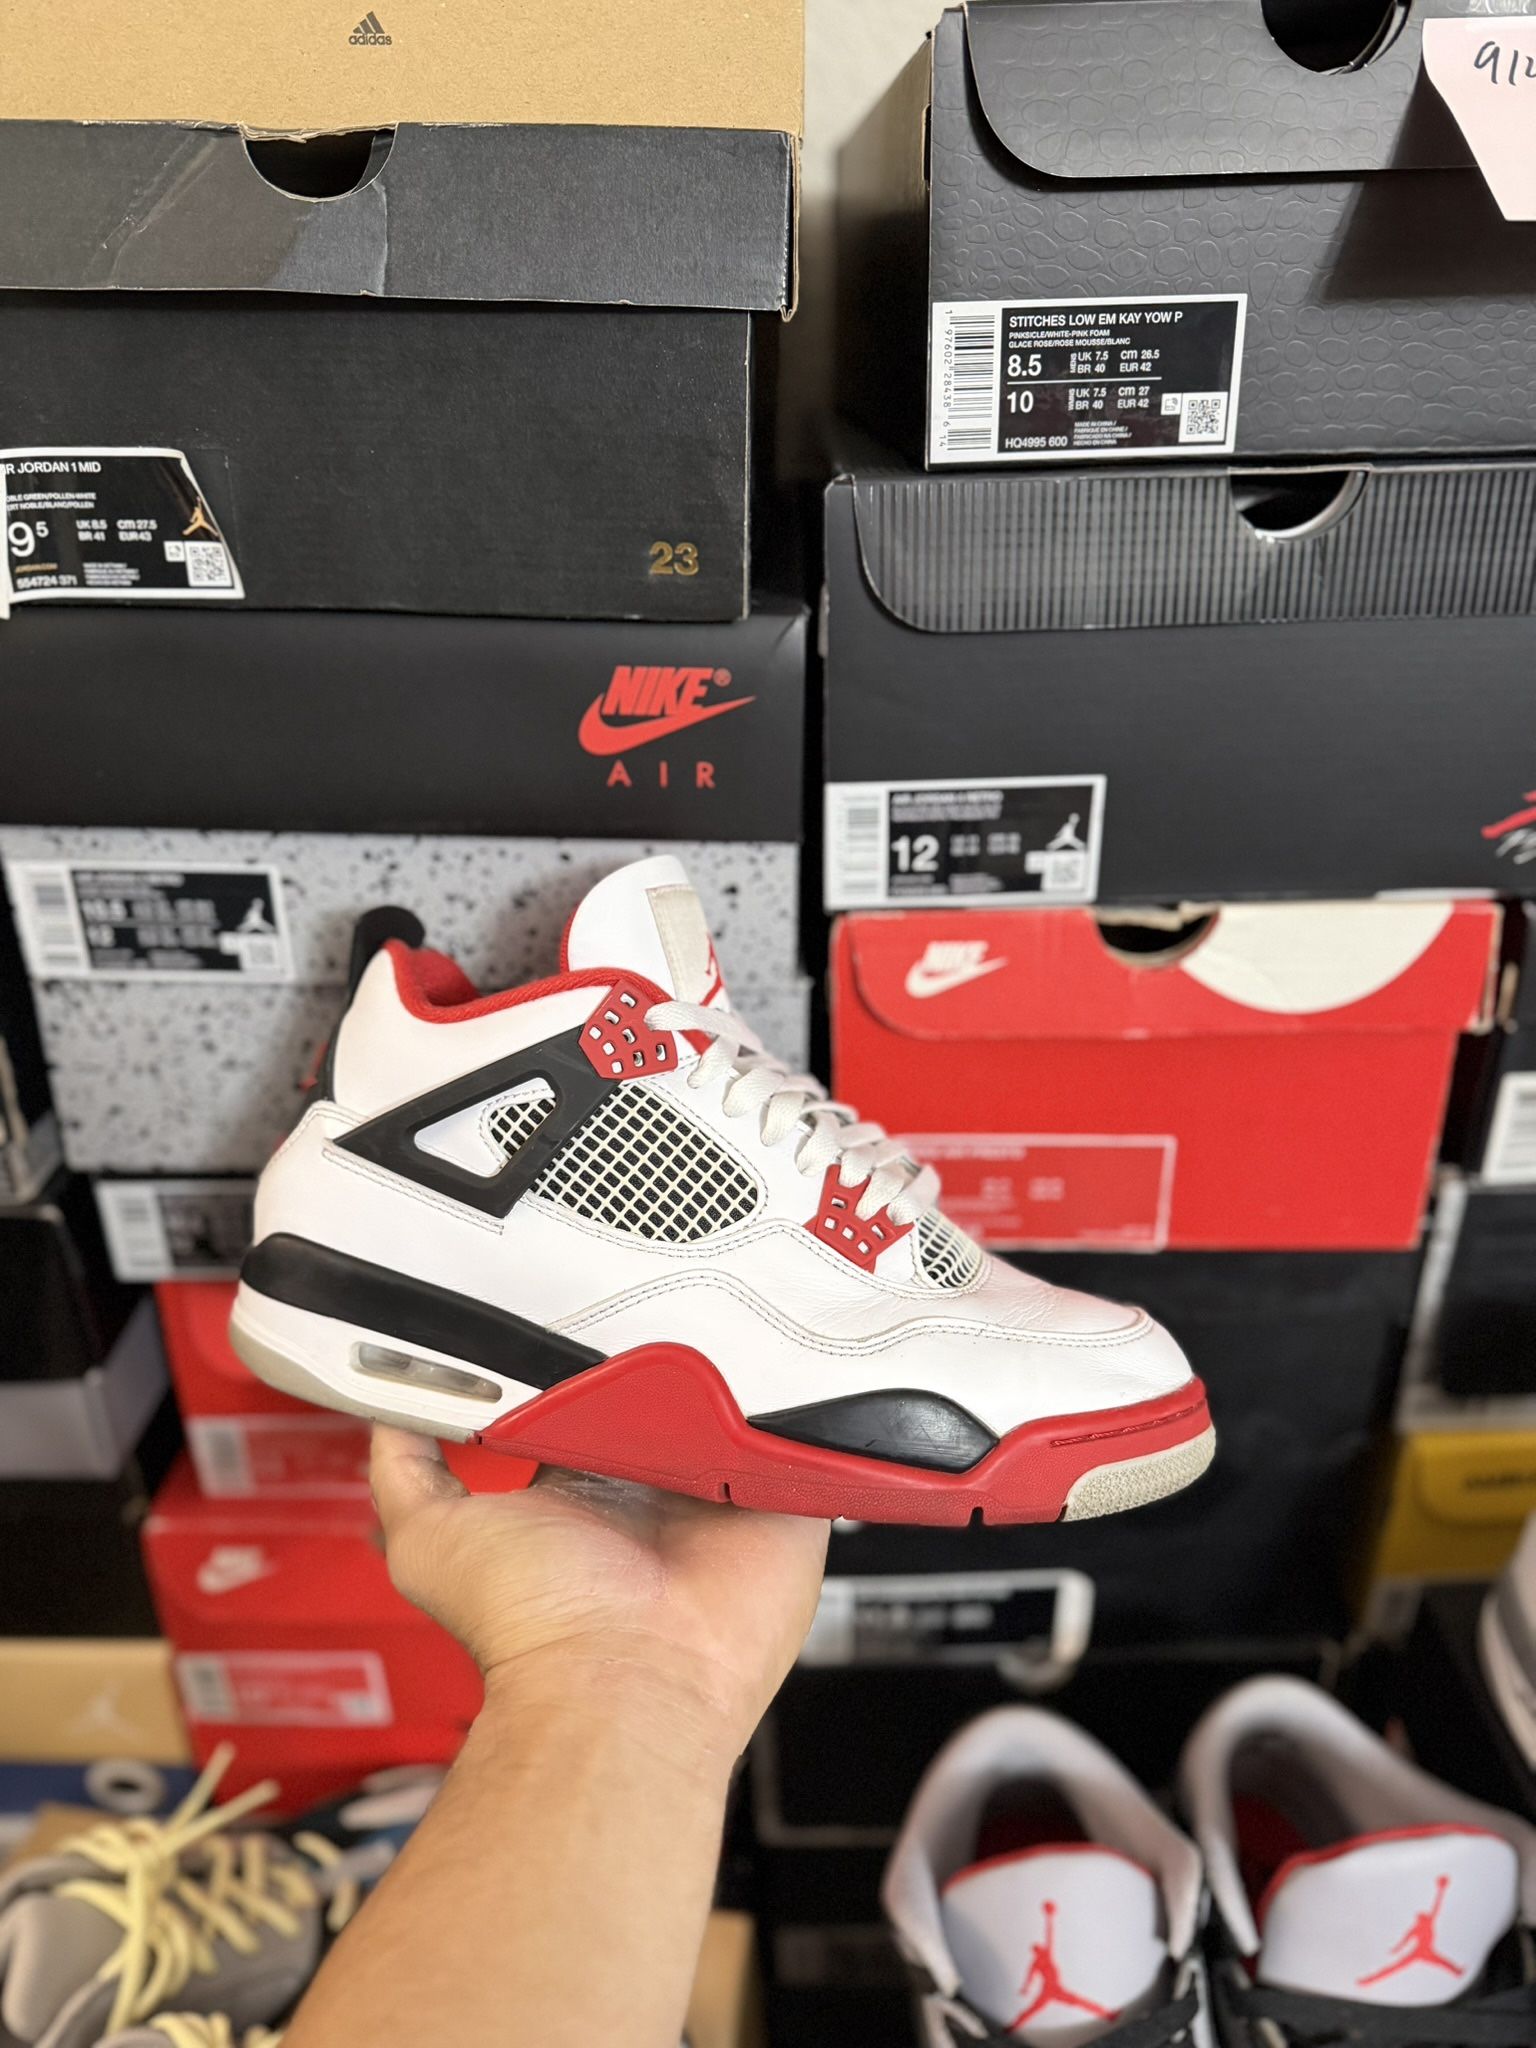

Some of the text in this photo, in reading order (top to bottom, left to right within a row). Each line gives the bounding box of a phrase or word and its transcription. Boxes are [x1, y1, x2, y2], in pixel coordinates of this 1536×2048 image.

[348, 33, 393, 46] adidas
[1009, 311, 1183, 329] STITCHES LOW EM KAY YOW P
[1009, 329, 1111, 340] PINKSICLE/WHITE-PINK FOAM
[944, 328, 953, 365] 97602
[1009, 337, 1131, 349] GLACE ROSE/ROSE MOUSSE/BLANC
[1077, 350, 1160, 362] UK 7.5 cm 26.5
[1007, 354, 1042, 378] 8.5
[1077, 362, 1152, 375] BR 40 EUR 42
[943, 372, 952, 408] 28438
[1075, 386, 1150, 398] UK 7.5 cm 27
[1006, 390, 1034, 413] 10
[1075, 398, 1150, 411] BR 40 EUR 42
[1005, 436, 1068, 449] HQ4995 600
[17, 461, 69, 474] JORDAN
[71, 461, 77, 473] 1
[78, 461, 102, 474] MID
[76, 519, 91, 530] UK
[136, 519, 158, 530] 27.5
[8, 521, 49, 557] 9 5
[650, 541, 699, 576] 23
[602, 665, 714, 717] NIKE
[607, 759, 716, 789] AIR
[891, 835, 940, 873] 12
